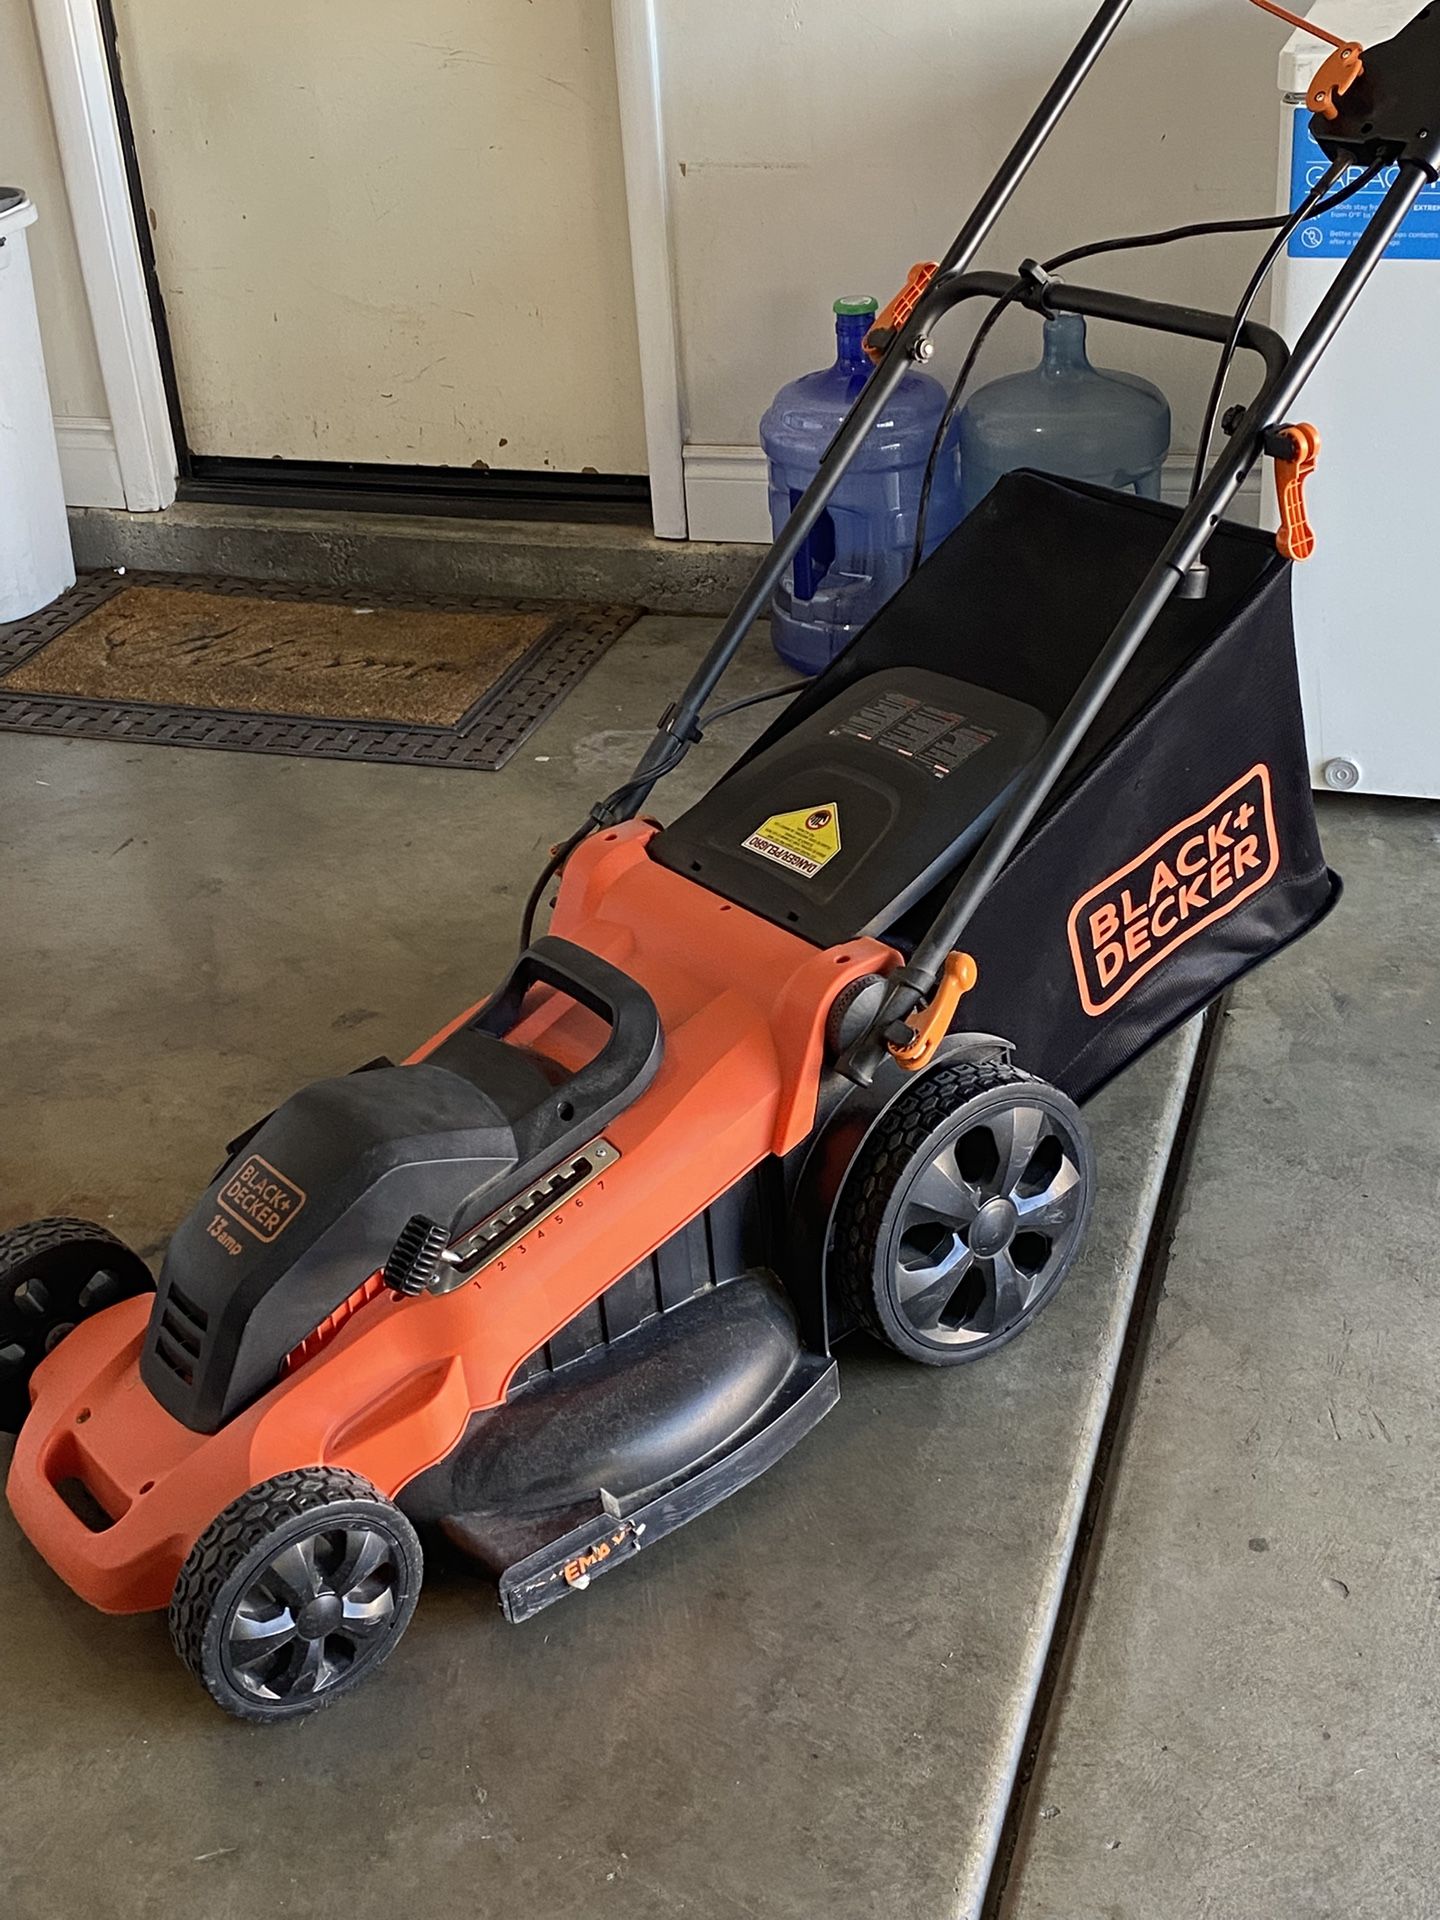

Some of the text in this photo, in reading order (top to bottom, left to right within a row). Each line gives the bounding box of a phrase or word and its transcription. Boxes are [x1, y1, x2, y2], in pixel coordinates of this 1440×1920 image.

[1353, 204, 1368, 212] stay
[748, 837, 818, 873] DANGER/PELIGRO
[1089, 802, 1255, 950] BLACK+
[1096, 834, 1262, 988] DECKER
[227, 1181, 281, 1231] DECKER
[240, 1165, 291, 1211] BLACK+
[473, 1180, 606, 1289] 1 2 3 4 5 6 7
